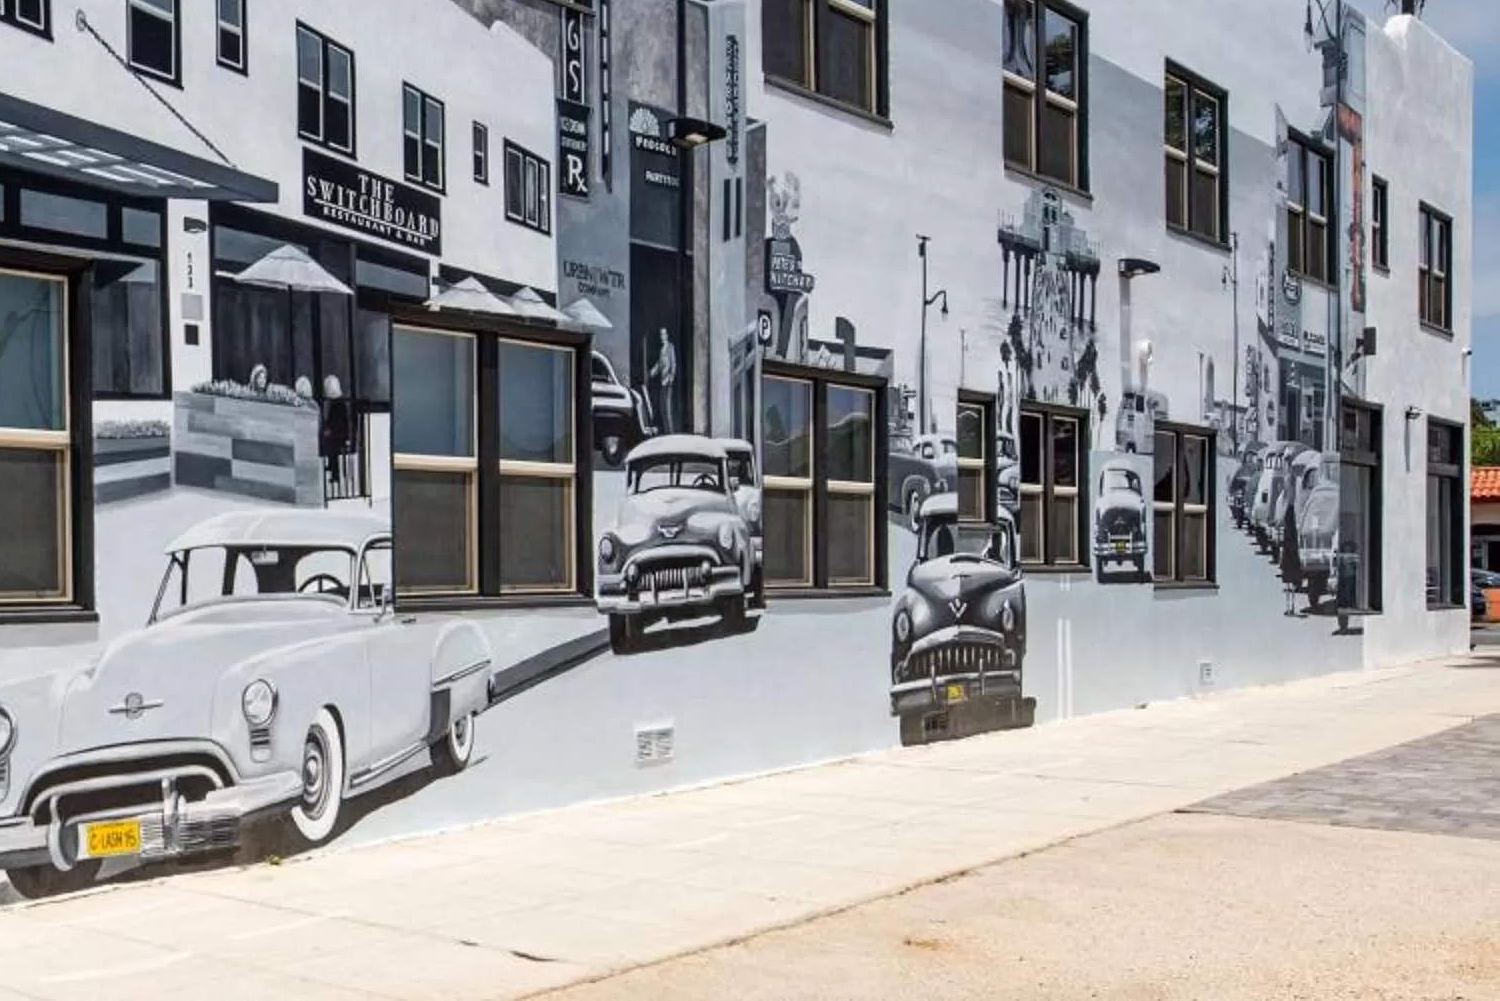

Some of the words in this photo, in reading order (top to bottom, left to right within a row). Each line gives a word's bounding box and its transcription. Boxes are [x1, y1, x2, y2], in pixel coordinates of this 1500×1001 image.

[358, 174, 395, 203] THE
[307, 175, 439, 238] SWITCHBOARD
[323, 206, 392, 238] RESTAURANT
